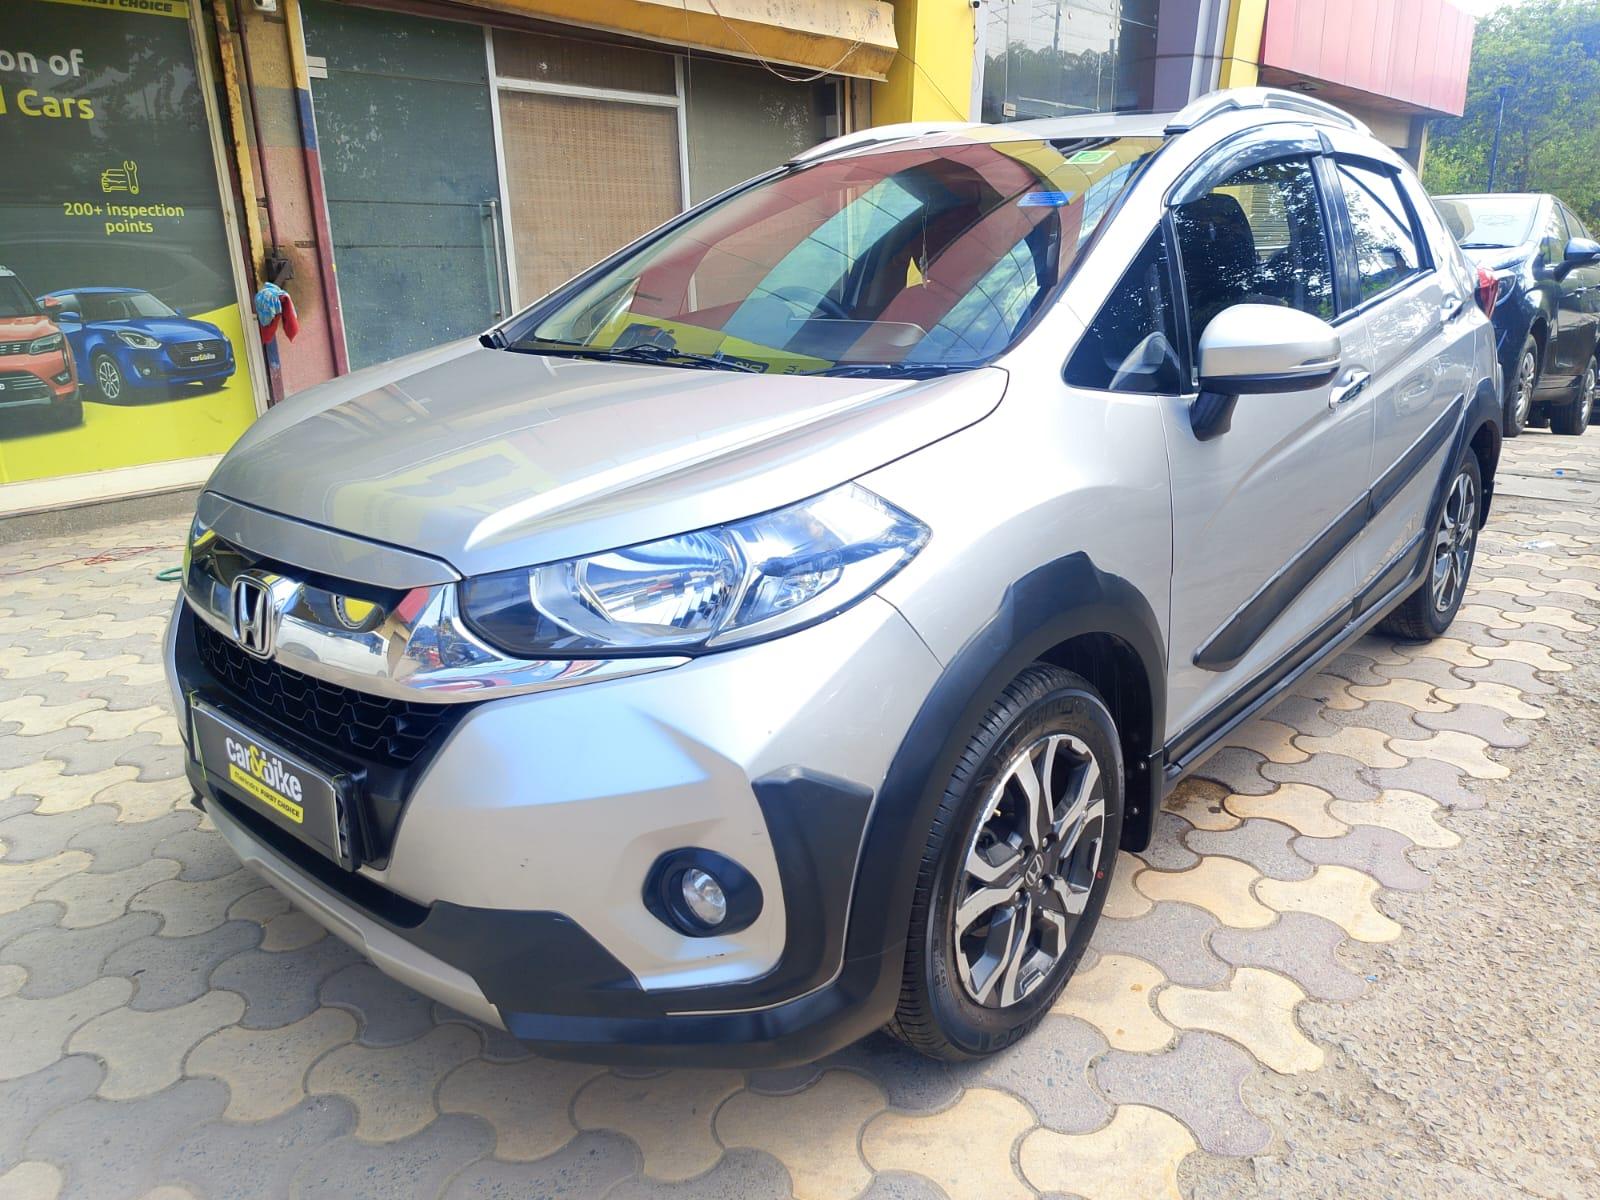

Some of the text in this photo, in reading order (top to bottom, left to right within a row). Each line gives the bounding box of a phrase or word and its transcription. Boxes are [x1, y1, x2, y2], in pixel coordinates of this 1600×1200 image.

[119, 0, 173, 12] CHOICE
[49, 48, 84, 77] of
[17, 89, 95, 119] Cars
[63, 202, 185, 219] 200+ inspection
[105, 219, 154, 235] points
[226, 737, 303, 802] car&bike
[277, 799, 301, 818] CHOICE
